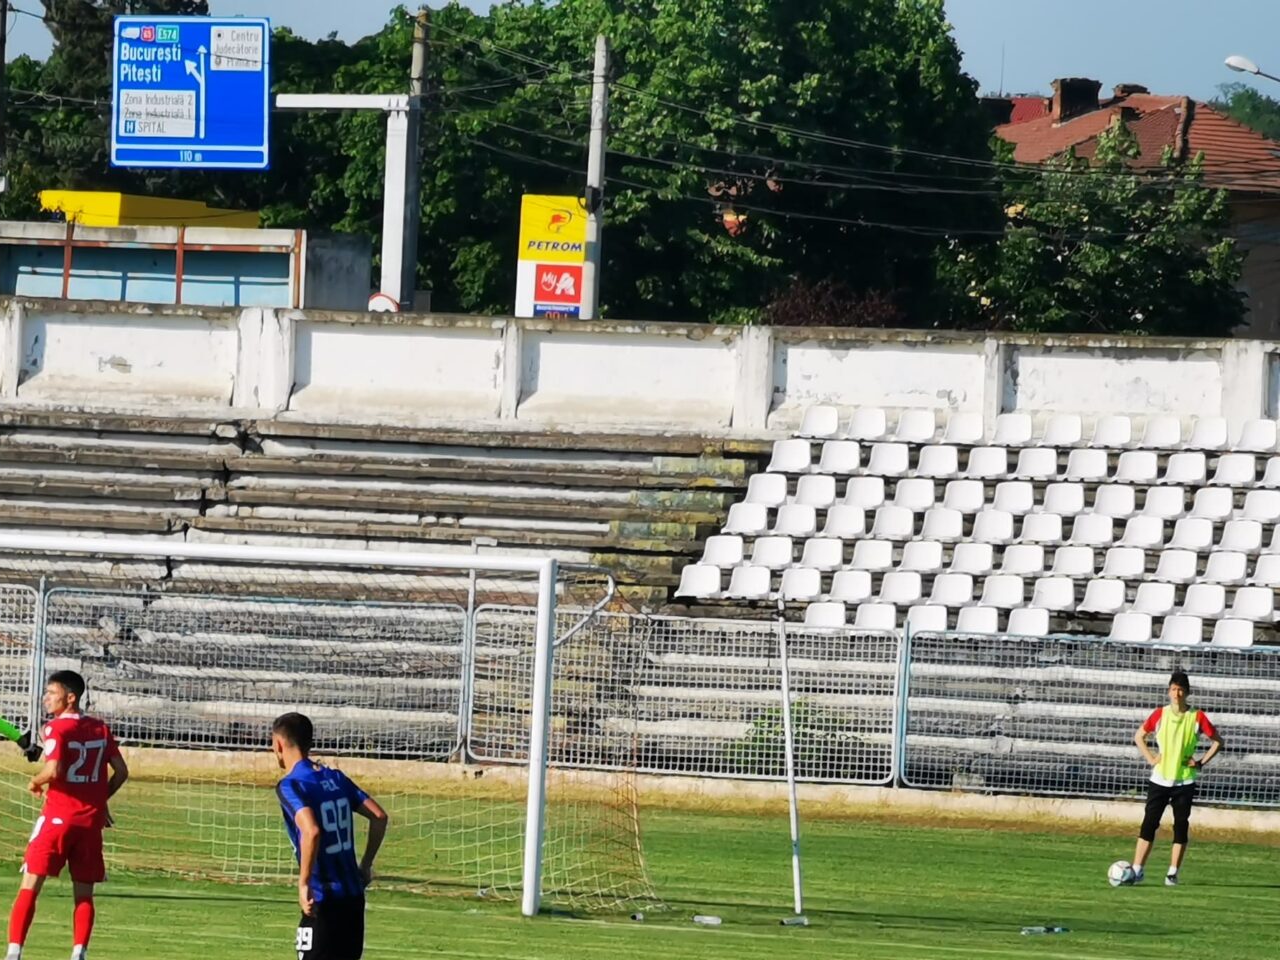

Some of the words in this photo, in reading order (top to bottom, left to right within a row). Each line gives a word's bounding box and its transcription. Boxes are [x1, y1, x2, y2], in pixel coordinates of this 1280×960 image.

[158, 28, 177, 40] E574
[231, 30, 259, 42] Centru
[121, 42, 181, 63] București
[120, 63, 161, 83] Pitești
[124, 93, 143, 105] Zona
[188, 95, 193, 106] 2
[138, 122, 166, 133] SPITAL
[180, 150, 193, 162] 110
[528, 240, 582, 252] PETROM
[67, 739, 107, 783] 27
[321, 797, 352, 855] 99
